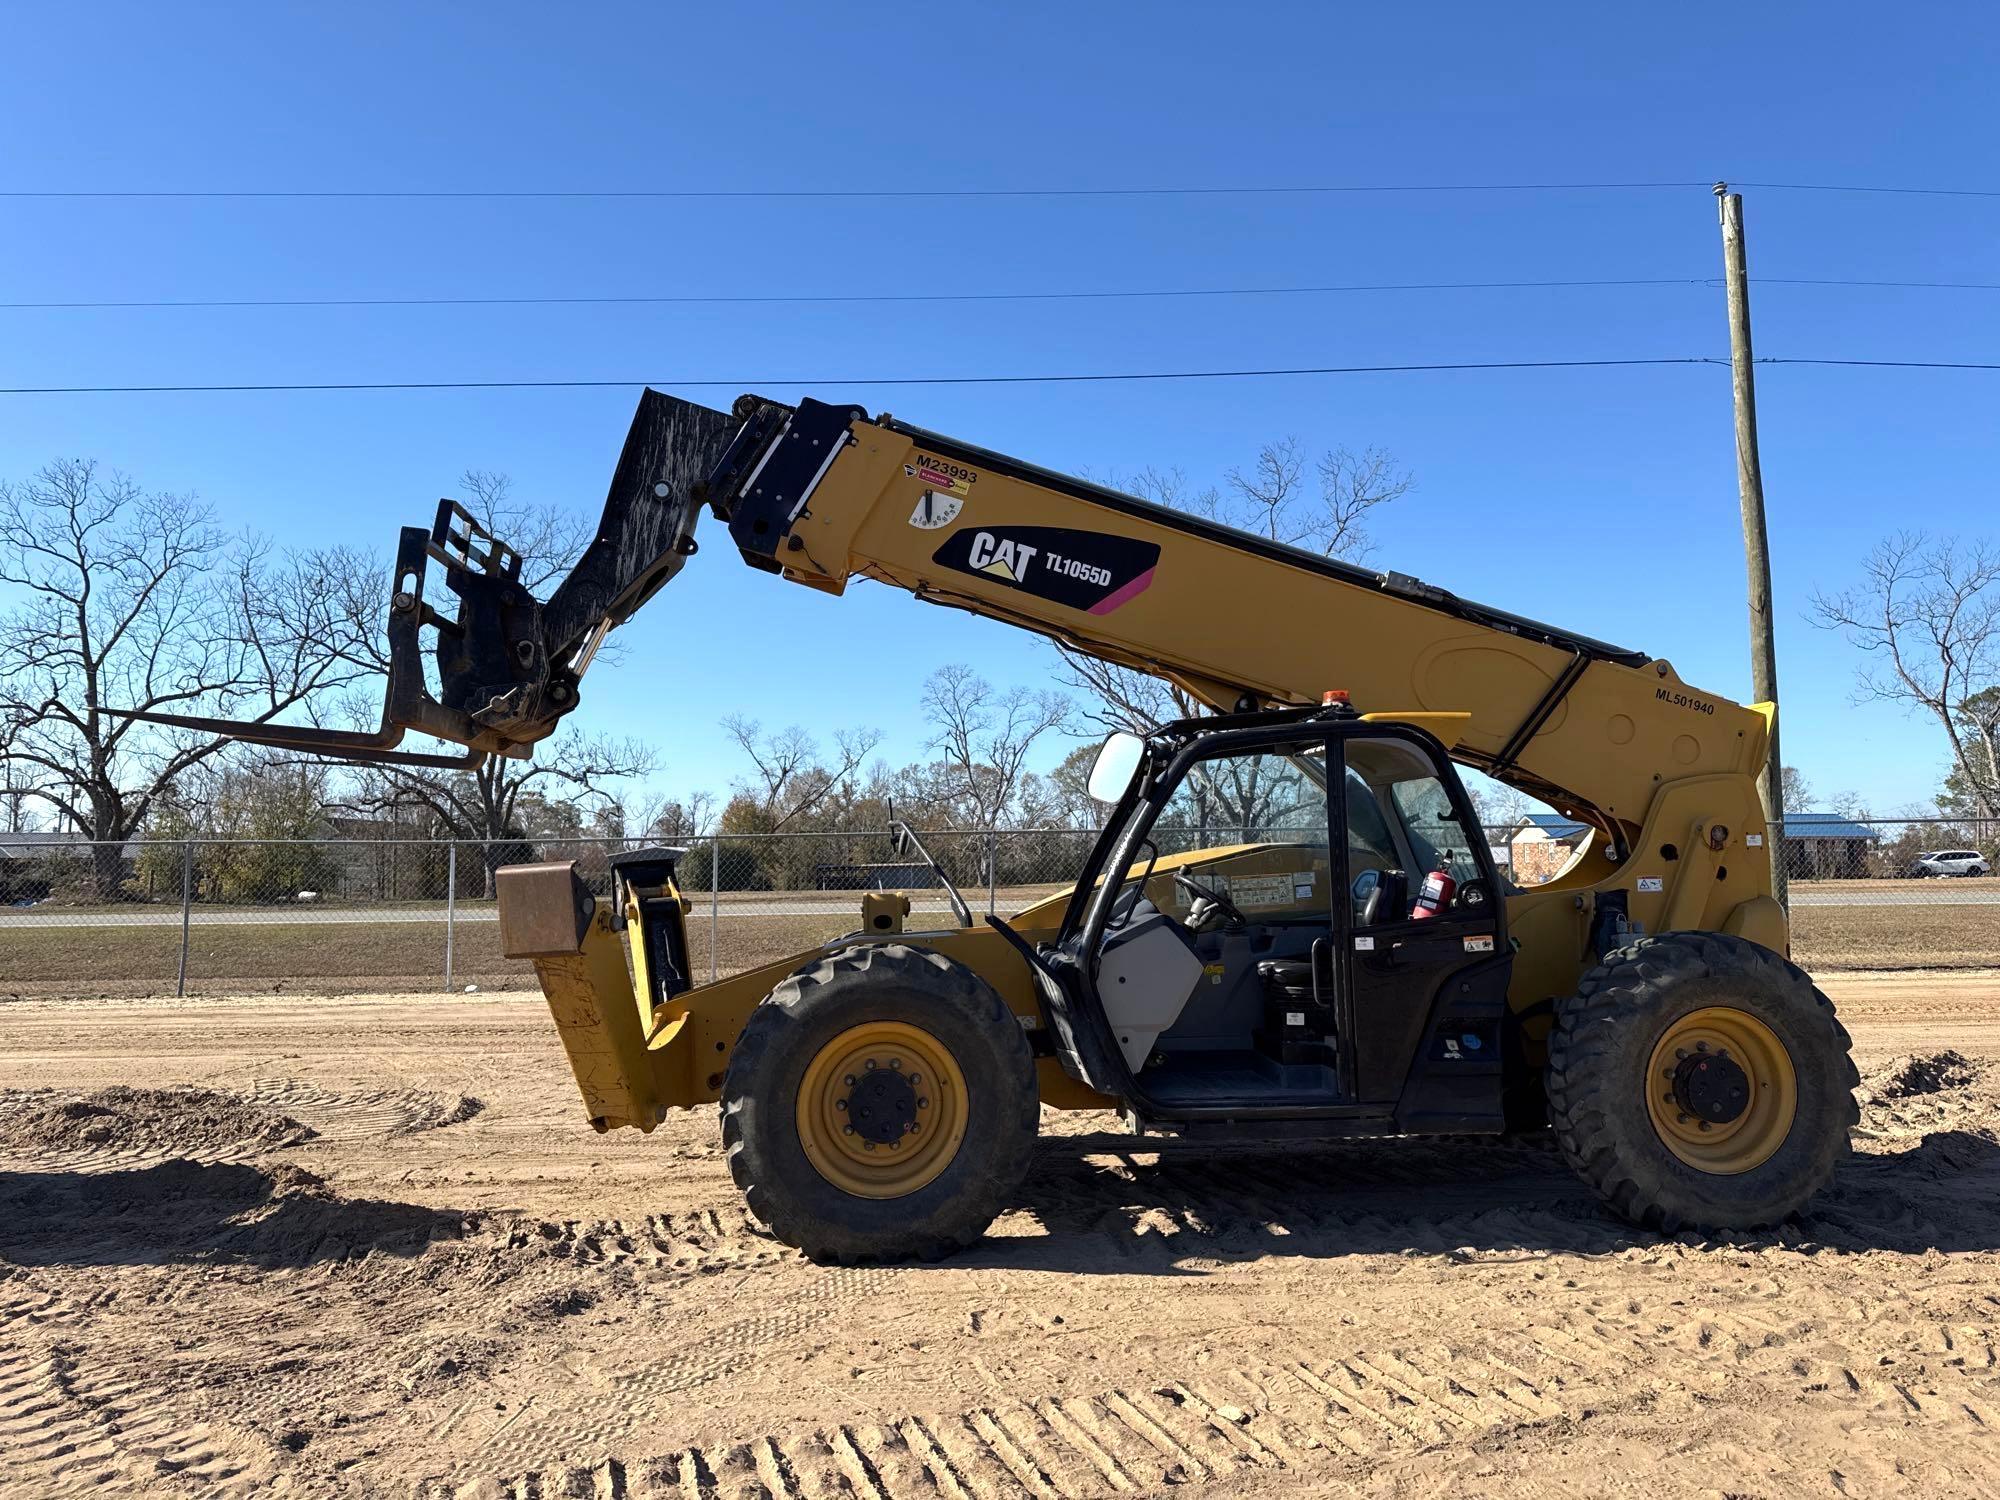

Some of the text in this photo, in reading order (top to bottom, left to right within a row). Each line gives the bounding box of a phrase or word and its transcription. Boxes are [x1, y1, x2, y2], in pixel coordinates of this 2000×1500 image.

[916, 455, 977, 483] M23993
[968, 532, 1037, 583] CAT
[1045, 552, 1112, 587] TL1055D
[1655, 688, 1714, 715] ML501940
